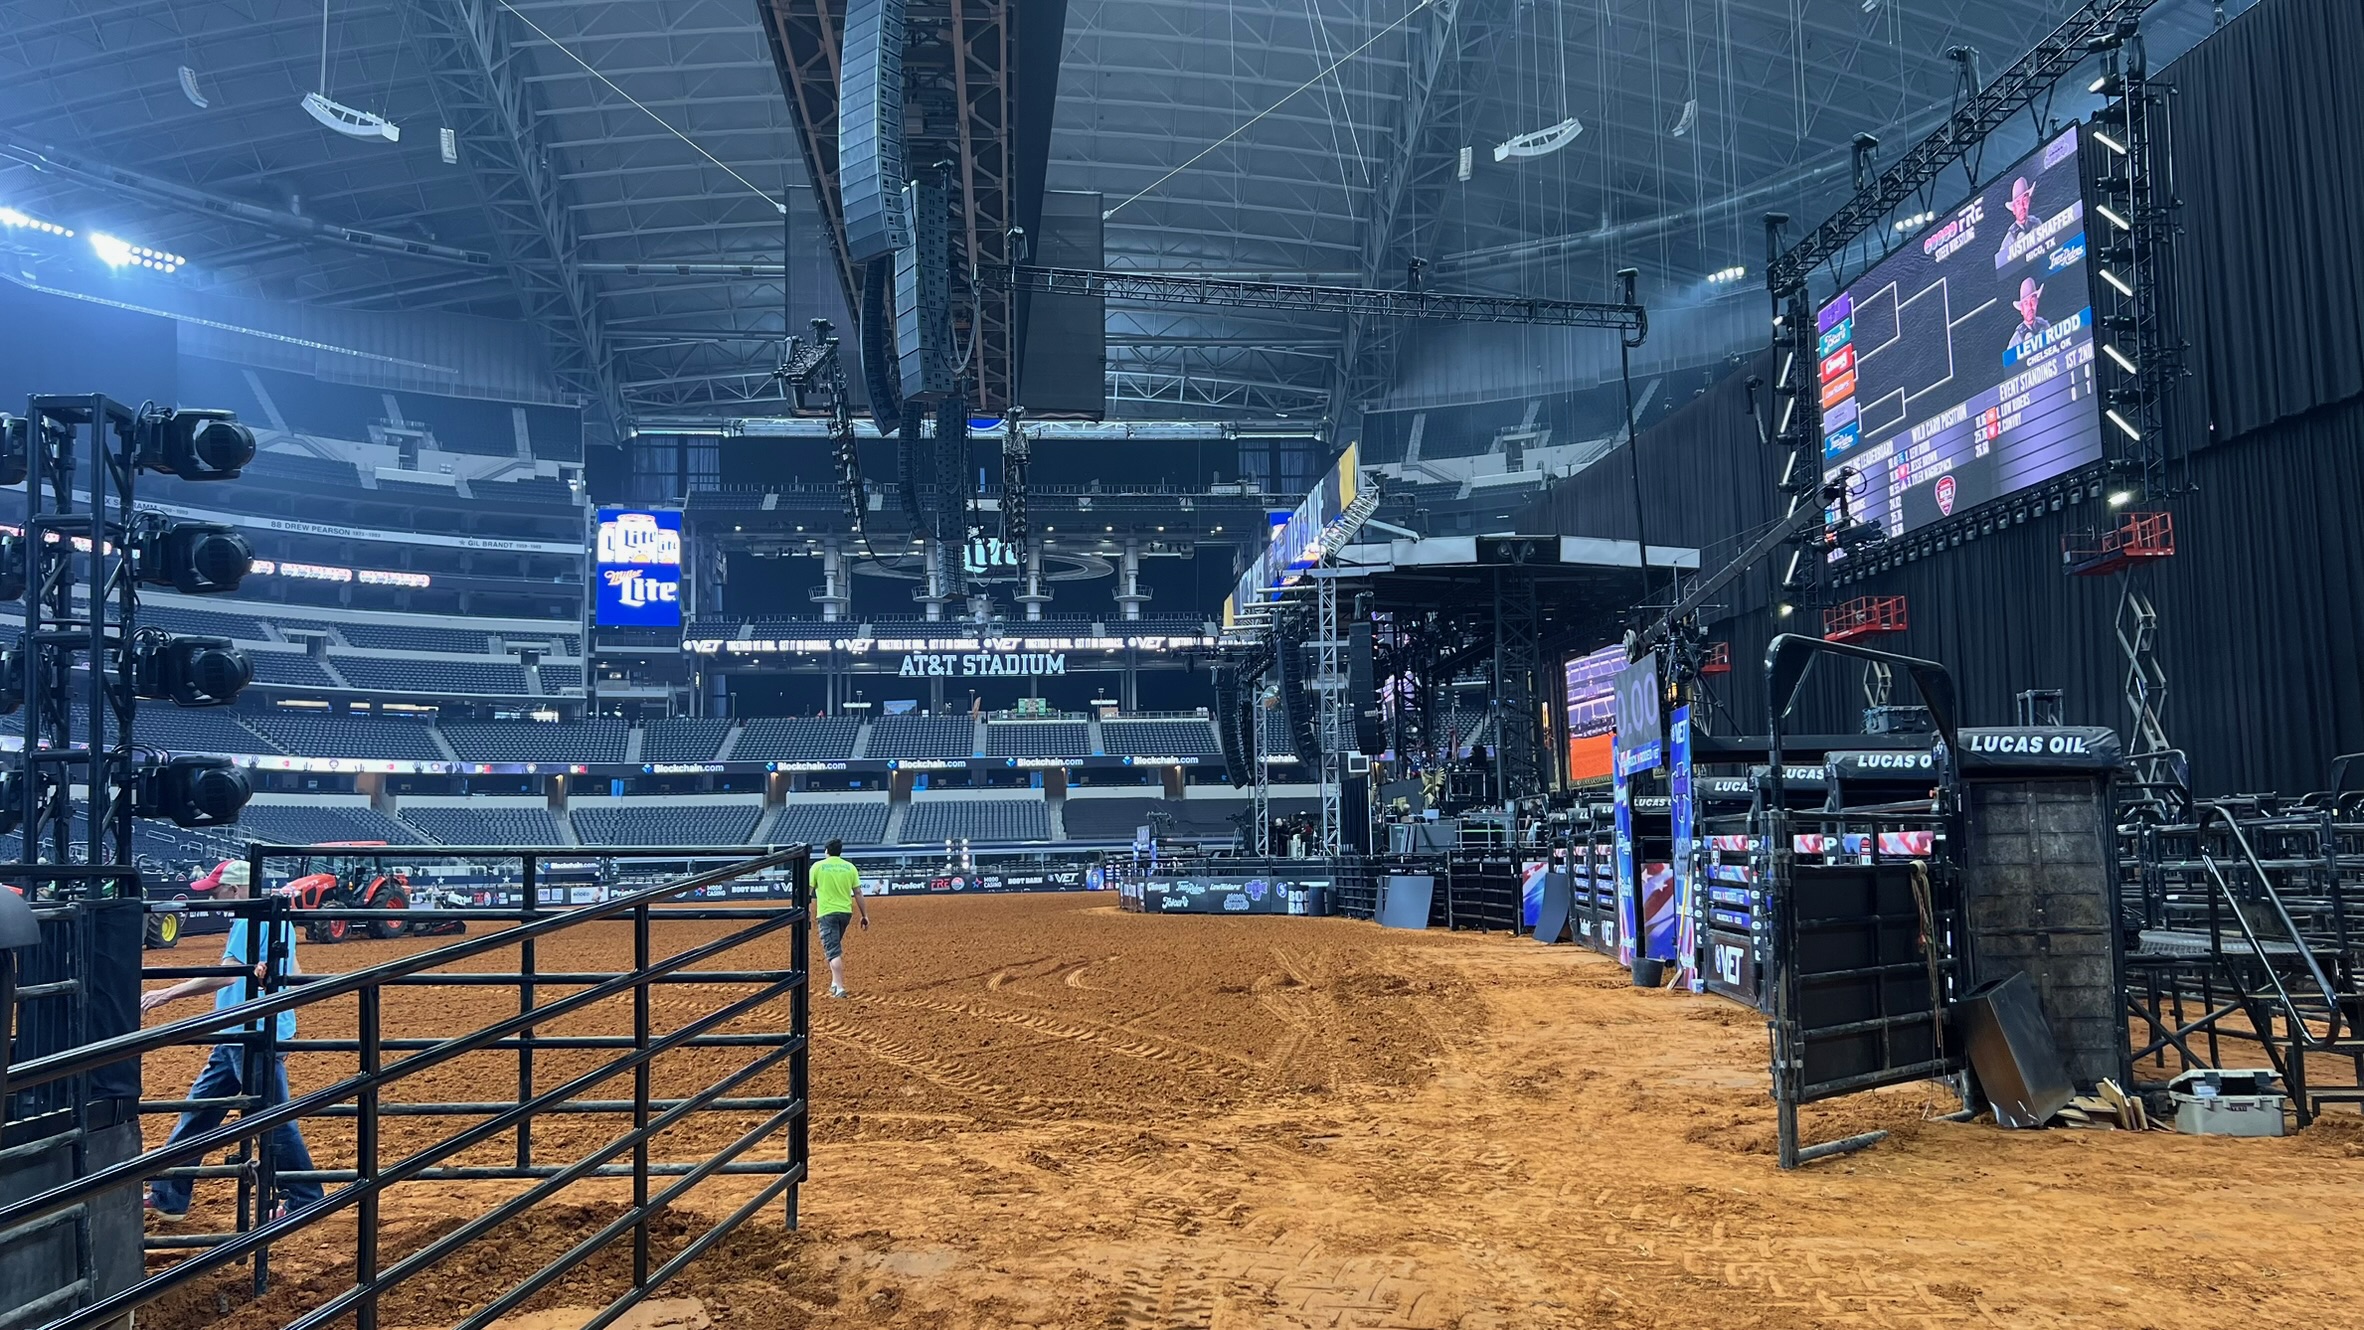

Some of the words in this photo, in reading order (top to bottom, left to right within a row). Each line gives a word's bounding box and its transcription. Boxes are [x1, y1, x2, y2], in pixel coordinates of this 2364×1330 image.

[2007, 231, 2035, 260] JUSTIN
[2036, 207, 2074, 242] SHAFFER
[2026, 245, 2045, 262] HICO,
[2045, 237, 2056, 250] TX
[2016, 333, 2042, 360] LEVI
[2045, 314, 2080, 344] RUDD
[2026, 346, 2060, 366] CHELSEA,
[2060, 337, 2072, 350] OK
[2065, 350, 2076, 370] 1ST
[2078, 342, 2093, 364] 2ND
[2000, 377, 2019, 402] EVENT
[2020, 359, 2058, 392] STANDINGS
[2070, 371, 2075, 384] 1
[2086, 380, 2091, 394] 1
[1941, 404, 1967, 430] POSITION
[284, 522, 310, 531] DREW
[312, 525, 350, 536] PEARSON
[482, 540, 513, 549] BRANDT
[604, 570, 643, 586] Miller
[619, 578, 677, 608] Lite
[692, 640, 723, 652] VET
[844, 639, 874, 651] VET
[992, 638, 1022, 650] VET
[1136, 637, 1166, 648] VET
[900, 654, 956, 676] AT&T
[962, 654, 1065, 675] STADIUM
[1616, 672, 1658, 738] 0.00
[1676, 720, 1687, 744] VET
[1970, 736, 2043, 753] LUCAS
[778, 761, 846, 771] Blockchain.com
[899, 759, 966, 769] Blockchain.com
[1017, 757, 1083, 767] Blockchain.com
[1133, 755, 1199, 765] Blockchain.com
[1858, 754, 1915, 768] LUCAS
[654, 763, 724, 773] Blockchain.com
[1782, 768, 1825, 780] UCAS
[1714, 782, 1754, 792] LUCA
[931, 879, 950, 889] FRE
[1055, 873, 1079, 882] VET
[892, 881, 926, 891] Priefert
[1692, 839, 1702, 945] Priefert
[1749, 840, 1762, 961] Priefert
[1720, 944, 1744, 986] VET
